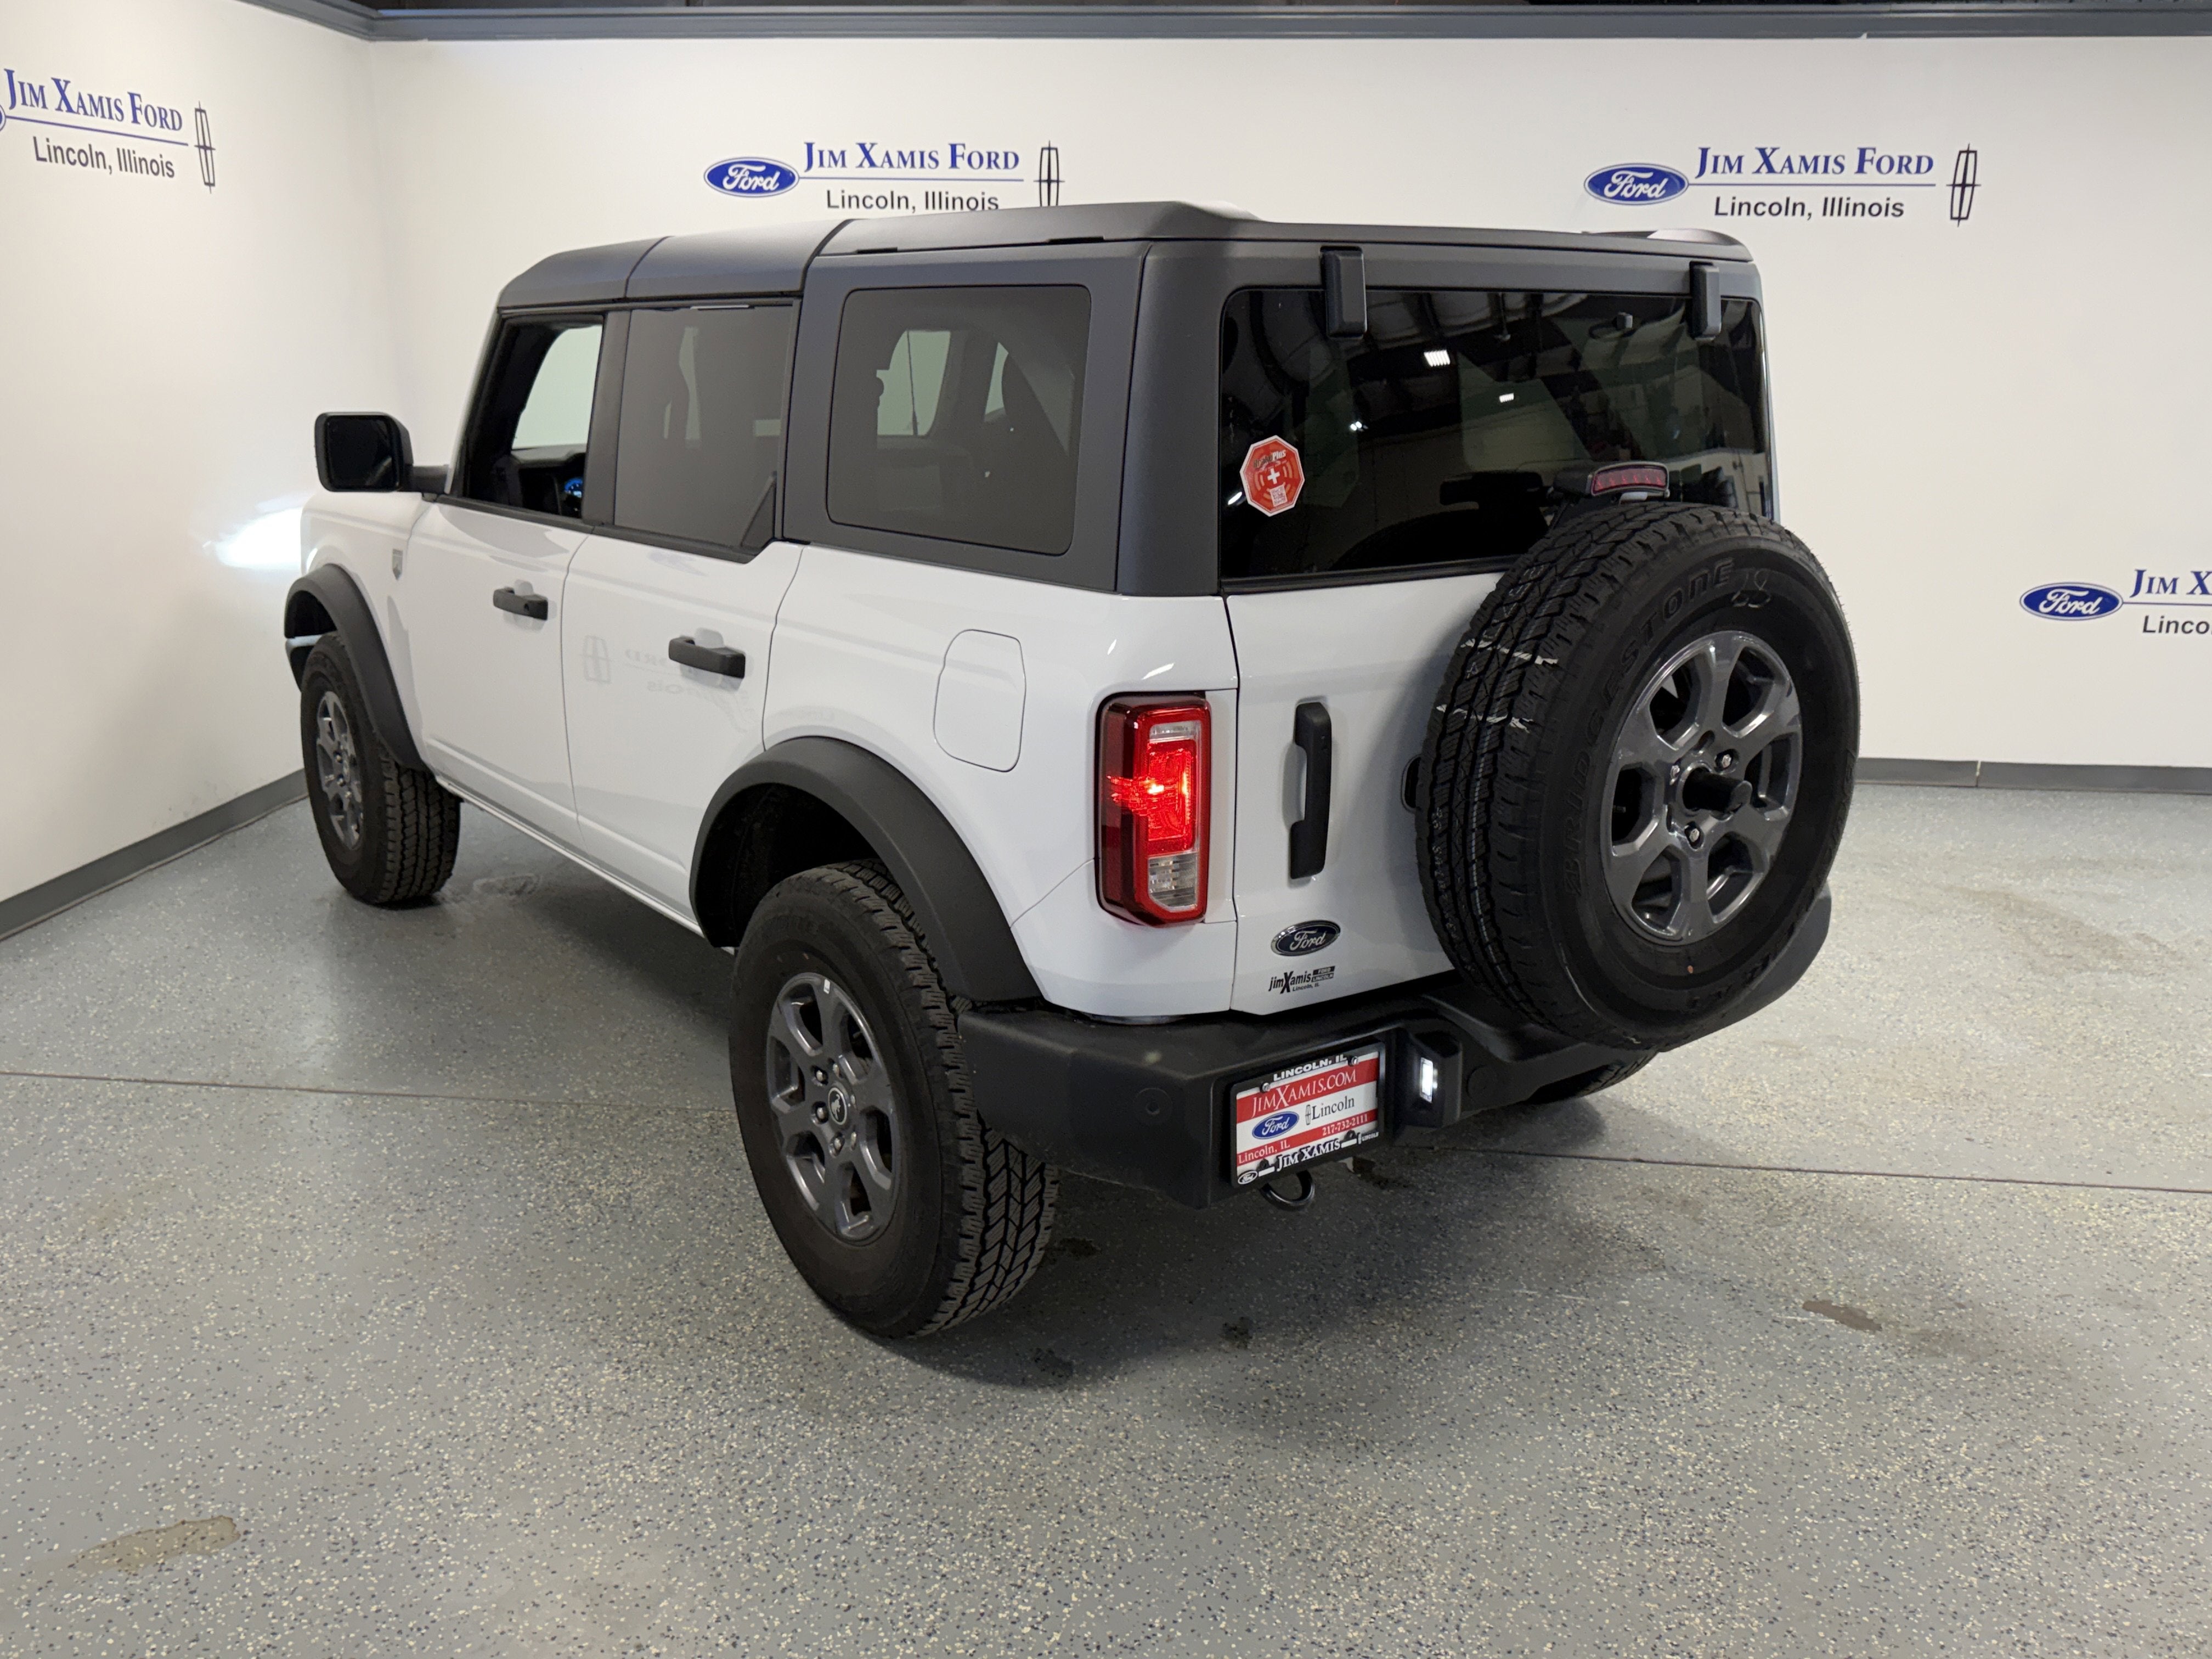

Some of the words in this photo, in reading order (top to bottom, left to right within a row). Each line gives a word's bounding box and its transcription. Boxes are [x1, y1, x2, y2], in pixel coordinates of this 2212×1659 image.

[32, 136, 113, 175] Lincoln,
[117, 147, 175, 178] Illinois
[723, 162, 780, 192] Ford
[1604, 170, 1666, 199] Ford
[826, 190, 917, 211] Lincoln,
[924, 191, 999, 211] Illinois
[1714, 196, 1812, 220] Lincoln,
[1822, 196, 1904, 218] Illinois
[2039, 589, 2103, 616] Ford
[1290, 930, 1327, 951] Ford
[1335, 1054, 1347, 1063] IL
[1312, 1096, 1355, 1120] Lincoln
[1262, 1116, 1290, 1136] Ford
[1322, 1114, 1368, 1136] 217-732-2111
[1238, 1145, 1278, 1164] Lincoln,
[1280, 1140, 1290, 1150] IL
[1277, 1154, 1299, 1171] JIM
[1301, 1140, 1341, 1162] XAMIS
